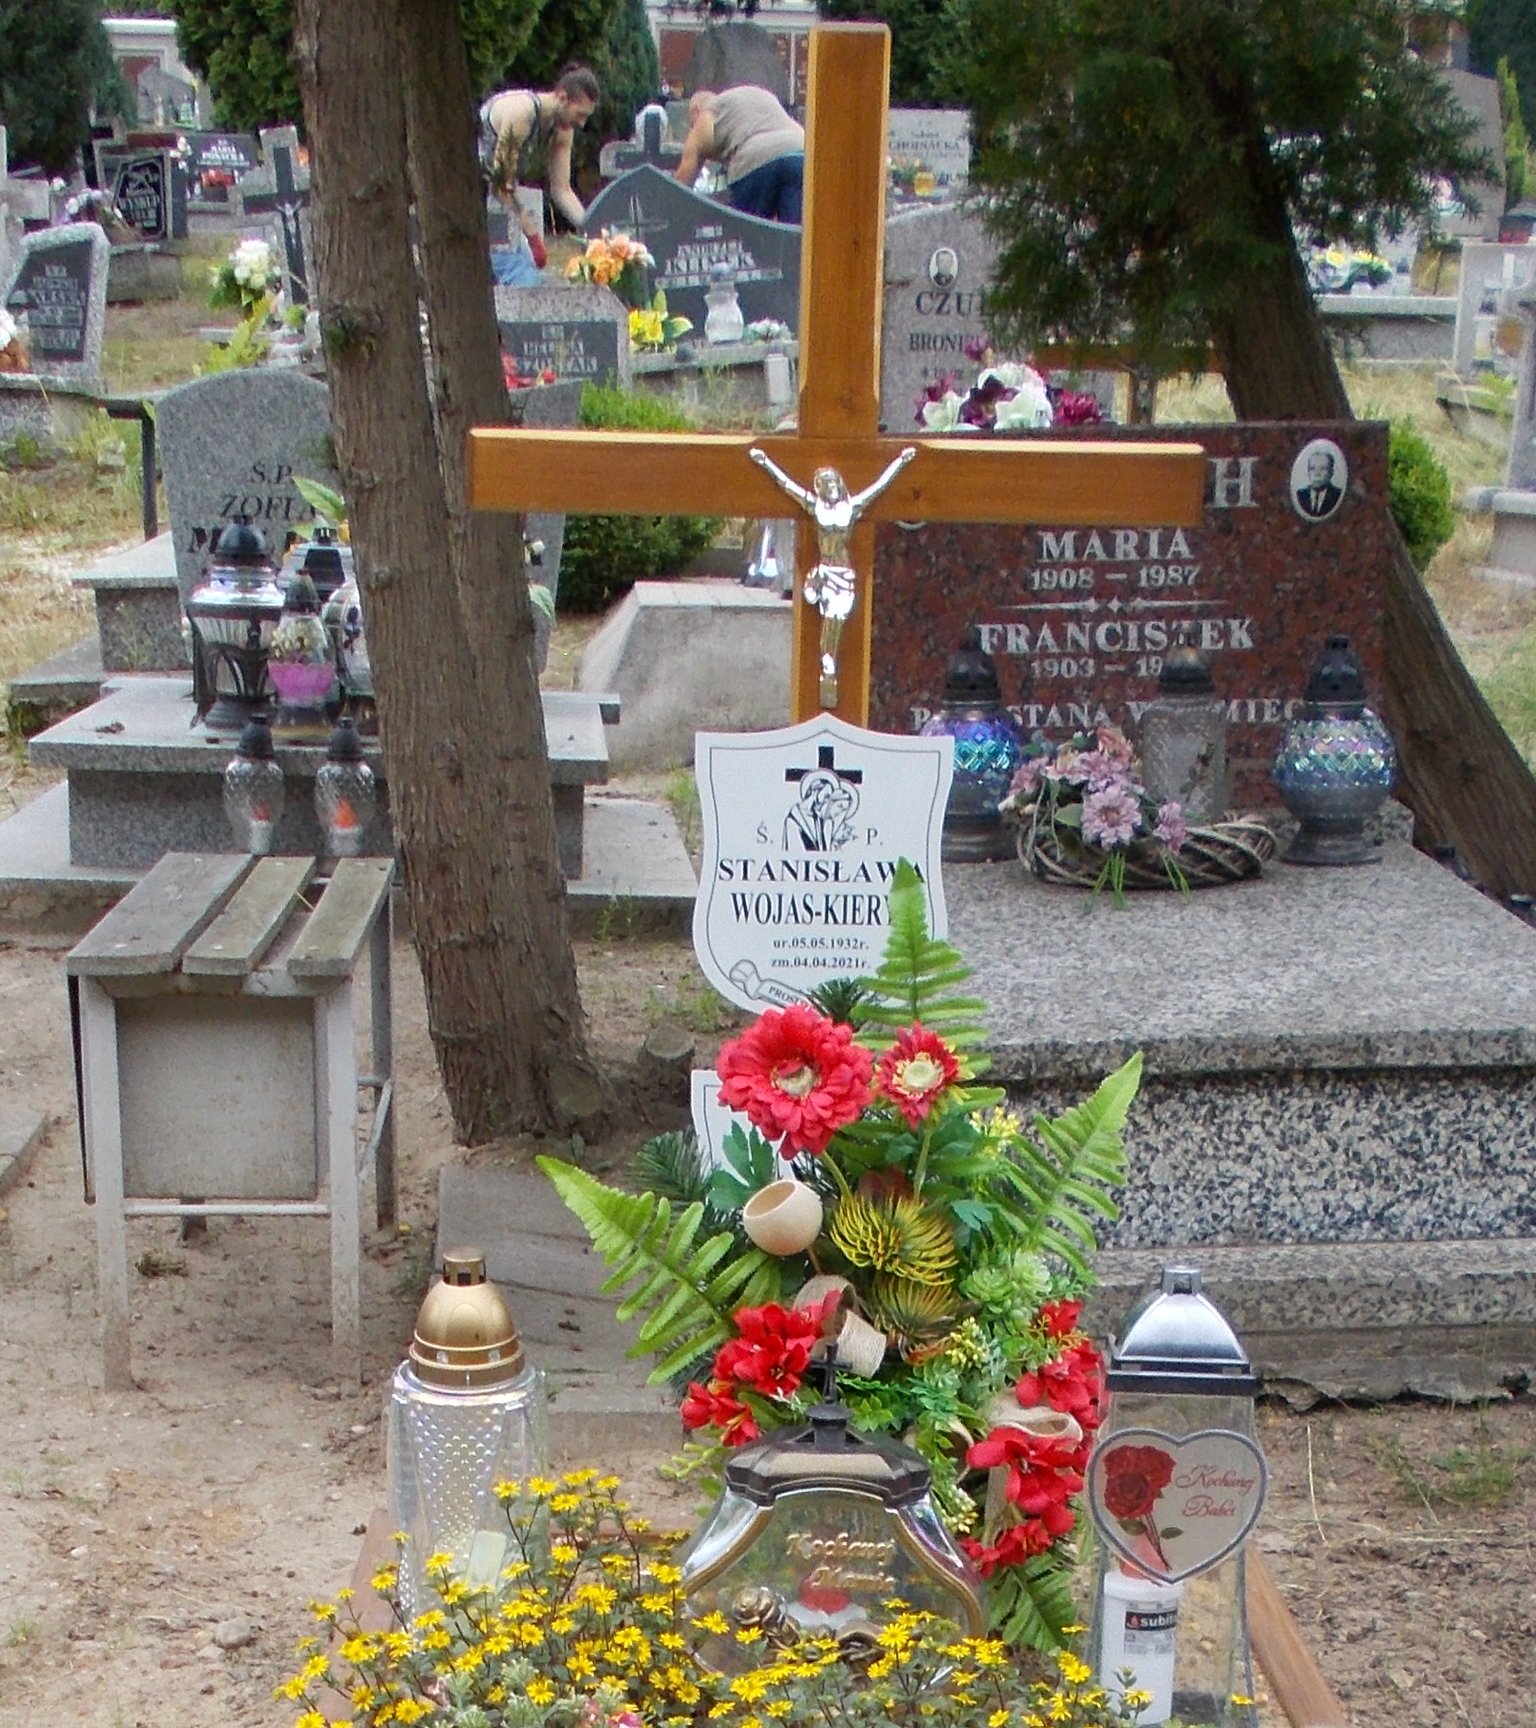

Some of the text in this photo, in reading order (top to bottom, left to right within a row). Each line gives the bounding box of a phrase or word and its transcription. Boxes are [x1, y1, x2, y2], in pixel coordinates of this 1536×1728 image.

[219, 494, 315, 519] ZOFI
[1038, 527, 1196, 563] MARIA
[1030, 567, 1096, 592] 1908
[1137, 564, 1201, 589] 1987
[1033, 657, 1096, 680] 1903
[756, 820, 884, 847] Ś. P.
[773, 936, 870, 951] ur.05.05.1932r.
[770, 956, 872, 970] zm.04.04.2021r.
